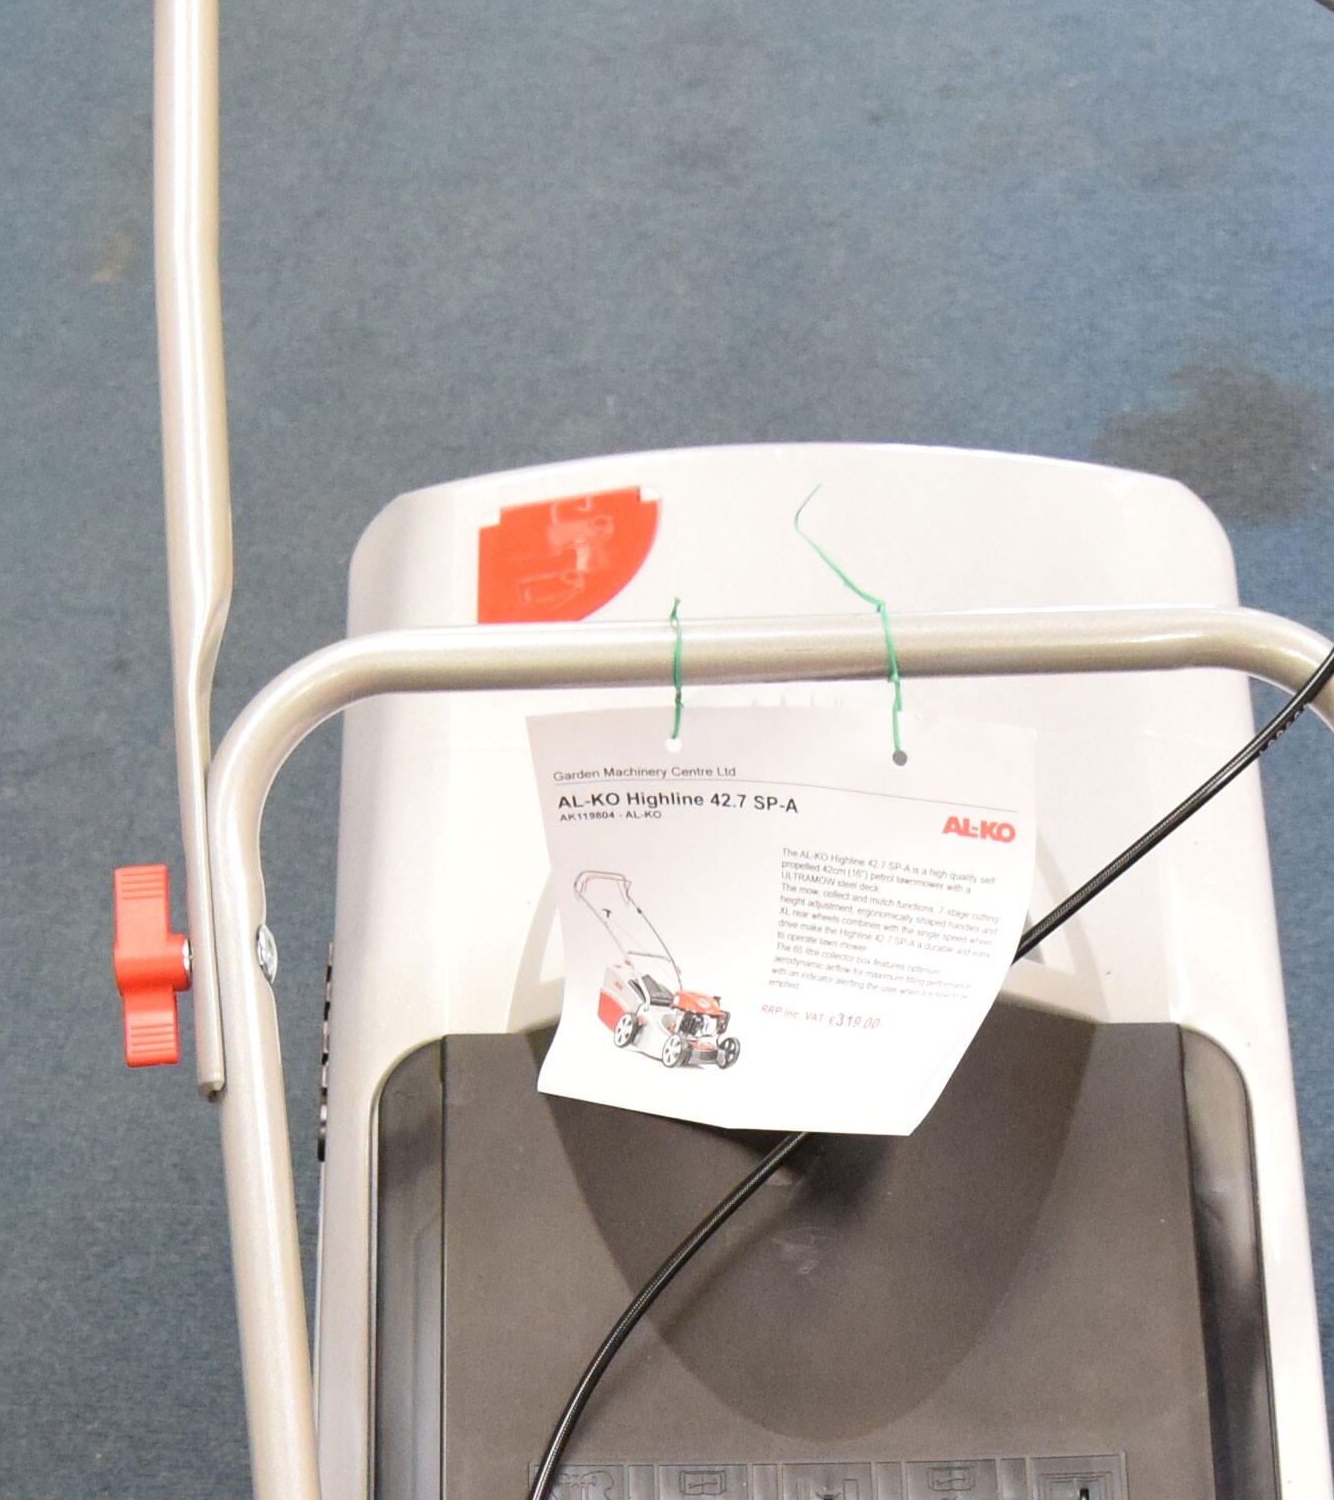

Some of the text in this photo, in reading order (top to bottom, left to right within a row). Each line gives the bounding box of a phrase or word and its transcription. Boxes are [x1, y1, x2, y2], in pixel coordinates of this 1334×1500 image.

[553, 766, 736, 782] Garden Machinery Centre Ltd
[558, 792, 799, 814] AL-KO Highline 42.7 SP-A
[625, 810, 662, 820] AL-KO
[942, 815, 1017, 844] AL-KO
[781, 861, 820, 873] propelled
[822, 865, 846, 876] 42cm
[870, 872, 894, 882] petrol
[897, 875, 944, 890] lawnmower
[947, 884, 963, 893] with
[783, 847, 797, 857] The
[831, 854, 865, 866] Highline
[930, 868, 948, 879] high
[950, 872, 977, 884] quality
[980, 876, 996, 884] self
[781, 871, 835, 886] ULTRAMOW
[837, 879, 857, 889] steel
[780, 895, 805, 907] height
[857, 907, 913, 925] ergonomically
[916, 916, 946, 928] shaped
[948, 921, 980, 932] handles
[982, 927, 997, 935] and
[781, 882, 797, 892] The
[823, 889, 850, 900] collect
[852, 894, 867, 903] and
[869, 896, 895, 906] mulch
[947, 909, 969, 920] stage
[971, 912, 999, 924] cutting
[778, 919, 798, 929] drive
[800, 923, 822, 932] make
[825, 926, 837, 935] the
[840, 928, 872, 940] Highline
[924, 942, 954, 952] durable
[779, 907, 789, 916] XL
[792, 910, 809, 918] rear
[811, 912, 840, 923] wheels
[842, 917, 881, 930] combines
[883, 924, 898, 933] with
[902, 926, 914, 935] the
[917, 929, 940, 940] single
[943, 934, 967, 943] speed
[777, 931, 785, 939] to
[787, 933, 818, 944] operate
[819, 937, 838, 947] lawn
[774, 955, 823, 969] aerodynamic
[866, 971, 904, 981] maximum
[777, 942, 791, 952] The
[822, 951, 855, 962] collector
[856, 956, 870, 965] box
[874, 958, 905, 970] features
[835, 977, 865, 990] alerting
[761, 1004, 782, 1015] RRP
